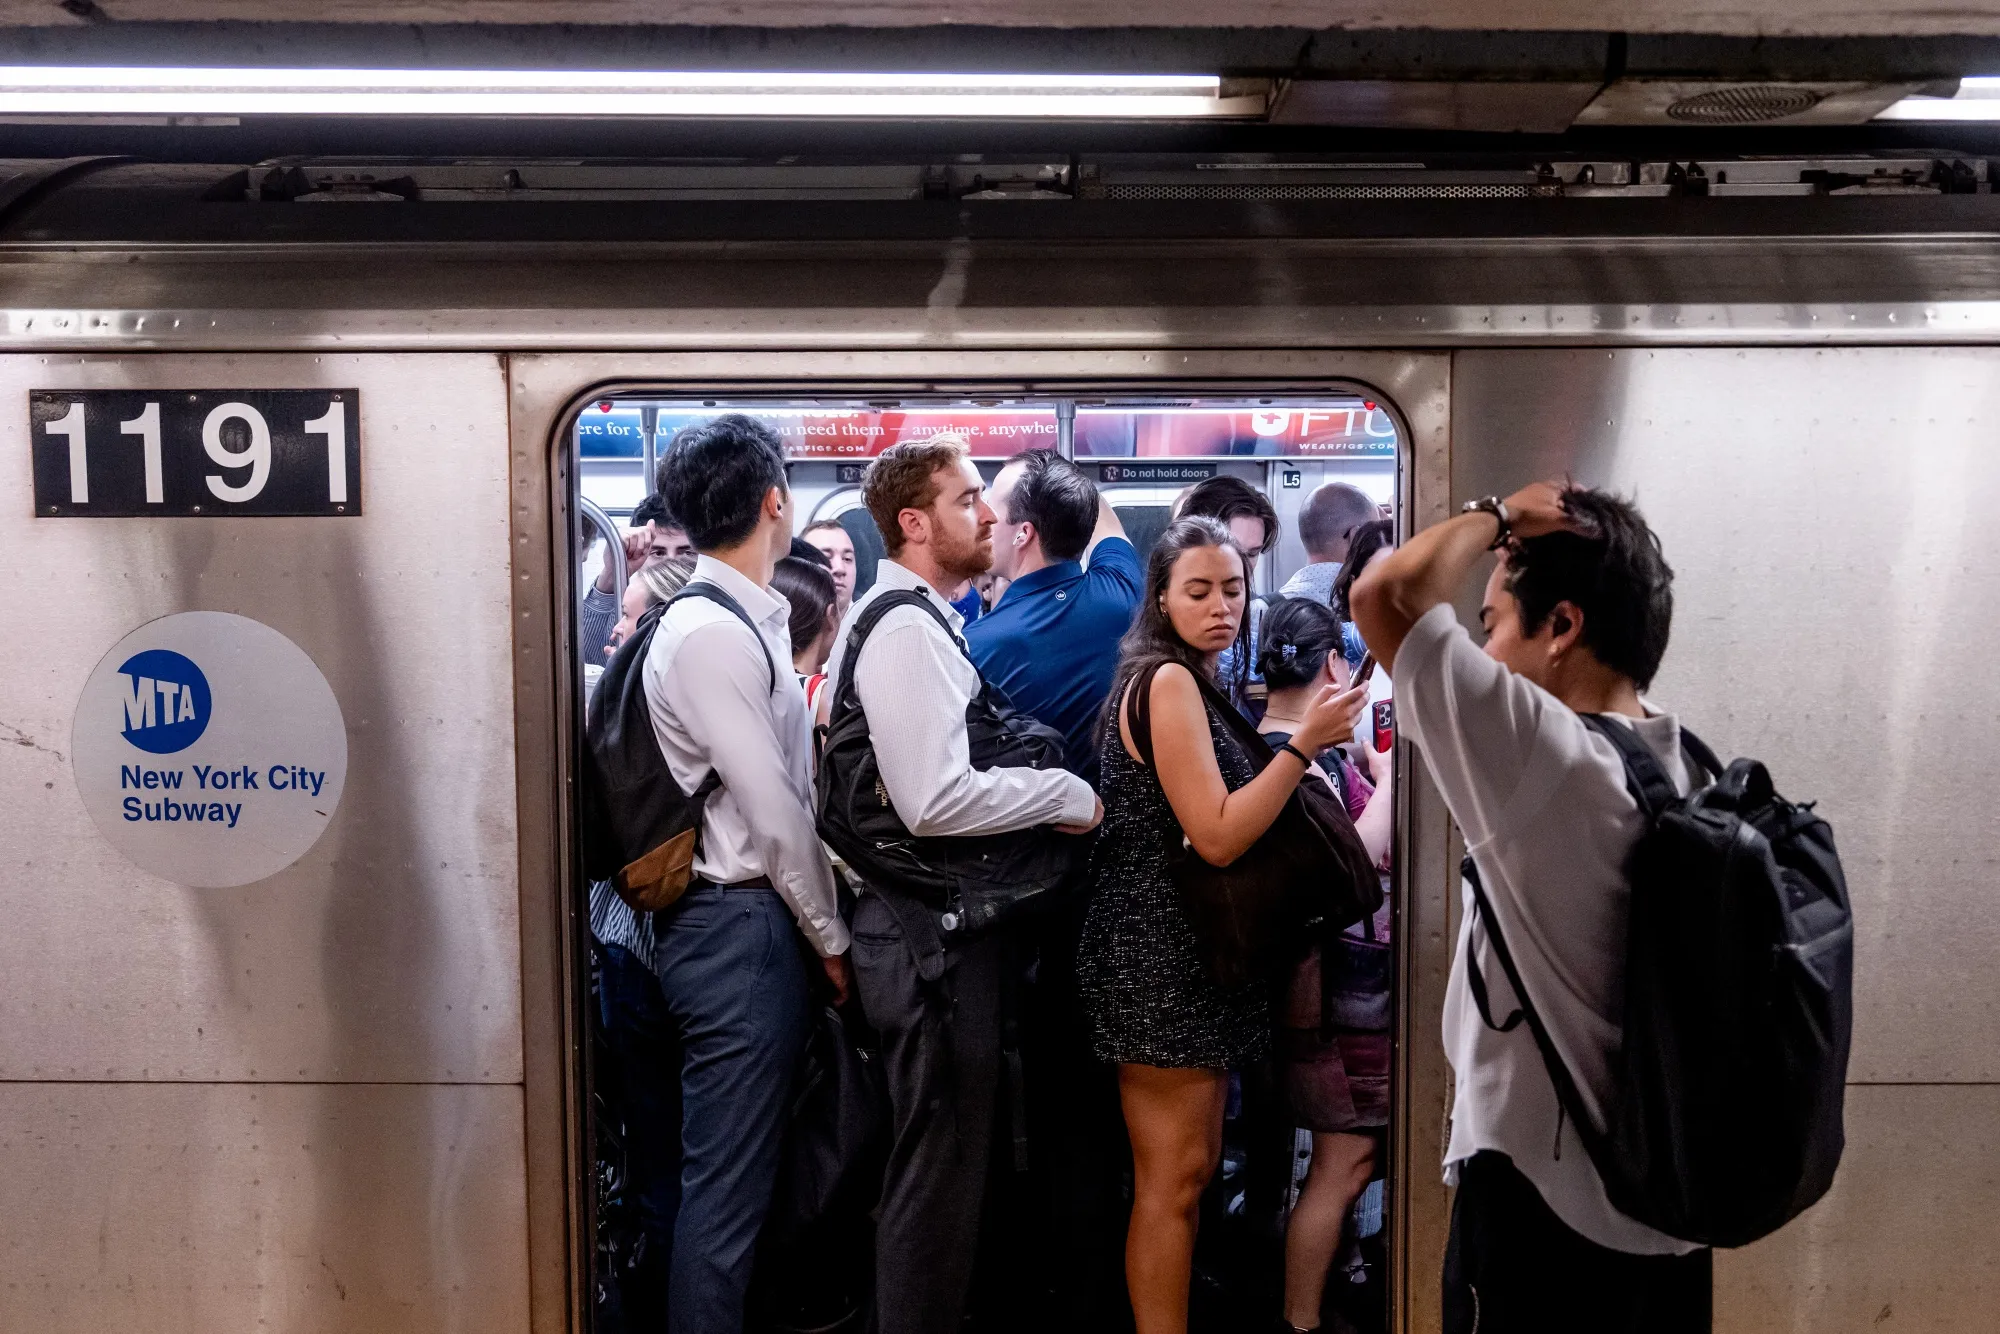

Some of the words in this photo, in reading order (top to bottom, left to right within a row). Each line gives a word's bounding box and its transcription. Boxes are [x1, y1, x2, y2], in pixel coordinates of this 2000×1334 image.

[579, 424, 603, 436] ere
[606, 421, 631, 437] for
[635, 427, 668, 439] yu
[796, 423, 837, 436] need
[841, 422, 885, 436] them
[912, 423, 984, 437] anytime,
[45, 401, 347, 504] 1191
[1122, 468, 1137, 478] Do
[1139, 468, 1155, 478] not
[1157, 468, 1179, 478] hold
[1181, 468, 1210, 478] doors
[1283, 474, 1300, 486] L5
[119, 672, 196, 732] MTA
[121, 765, 183, 790] New
[192, 765, 260, 790] York
[267, 765, 326, 797] City
[123, 796, 242, 828] Subway
